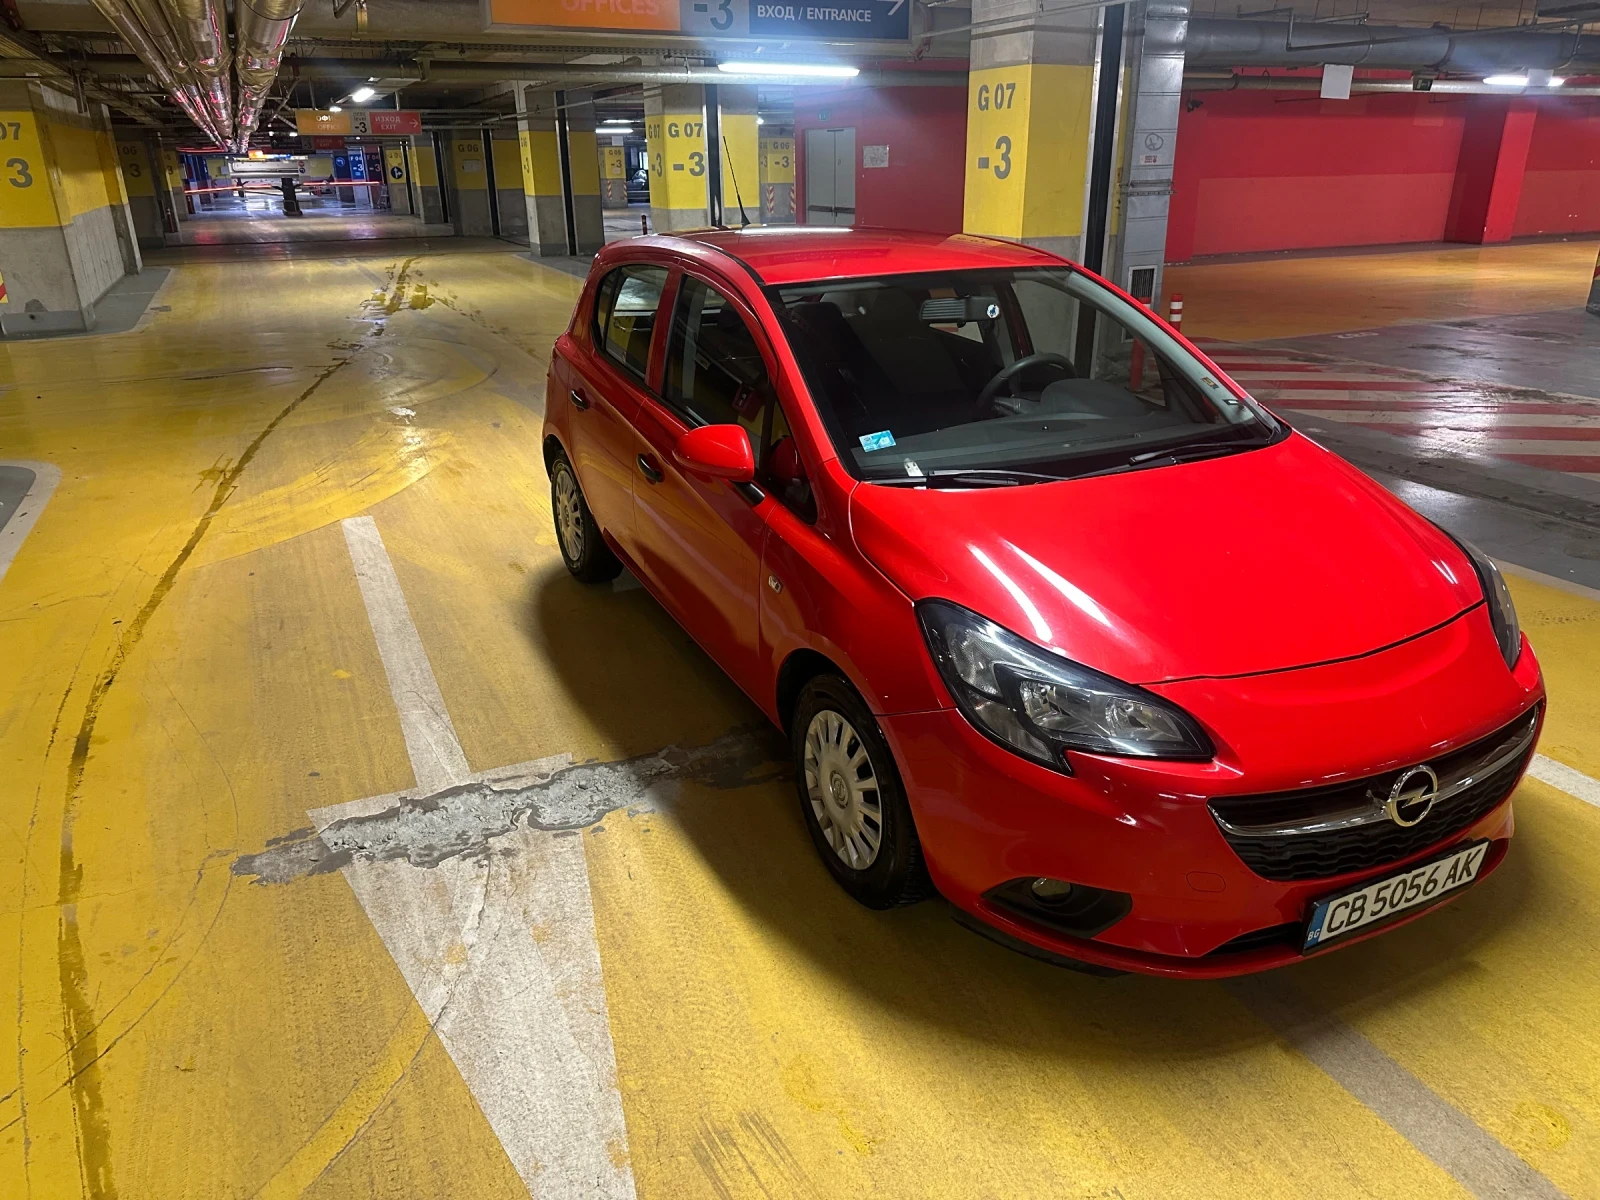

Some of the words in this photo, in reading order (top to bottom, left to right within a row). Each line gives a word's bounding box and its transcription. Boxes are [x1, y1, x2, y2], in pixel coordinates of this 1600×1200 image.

[757, 5, 795, 21] ВХОД
[806, 8, 871, 22] ENTRANCE
[977, 84, 990, 112] G
[994, 82, 1016, 111] 07
[375, 115, 401, 123] ИЗХОД
[355, 122, 367, 133] -3
[653, 123, 661, 139] 07
[668, 122, 680, 138] G
[684, 122, 704, 138] 07
[458, 144, 465, 152] G
[467, 144, 479, 152] 06
[773, 142, 779, 150] G
[780, 142, 790, 150] 06
[673, 151, 705, 177] -3
[773, 155, 790, 169] -3
[977, 135, 1012, 180] -3
[1307, 928, 1321, 941] BG
[1326, 893, 1368, 934] CB
[1370, 865, 1440, 918] 5056
[1442, 848, 1483, 889] AK
